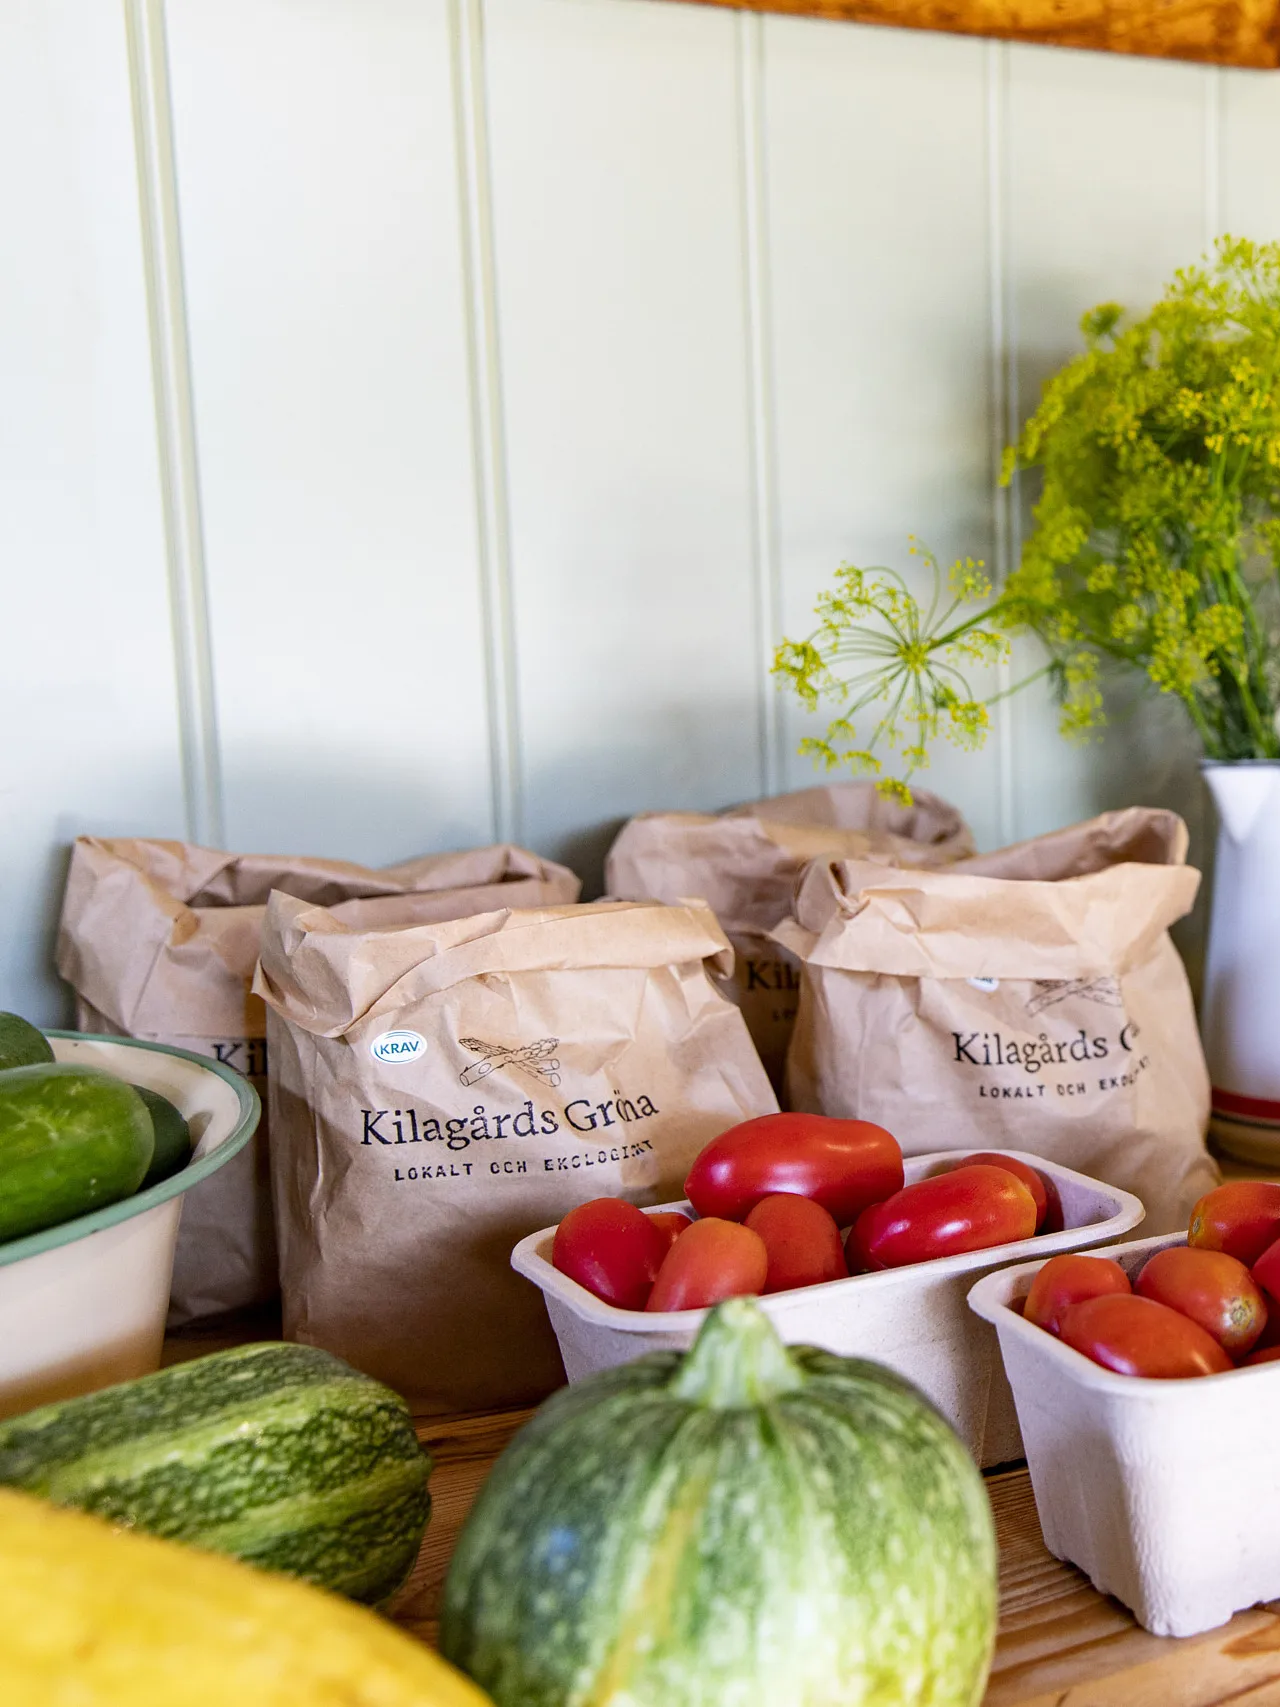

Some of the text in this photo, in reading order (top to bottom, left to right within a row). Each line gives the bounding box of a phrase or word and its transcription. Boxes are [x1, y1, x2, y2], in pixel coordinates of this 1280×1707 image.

[380, 1040, 419, 1055] KRAV
[952, 1030, 1109, 1074] Kilagårds
[979, 1082, 1086, 1098] LOKALT OCH
[360, 1100, 560, 1150] Kilagårds
[395, 1163, 473, 1181] LOKALT
[491, 1160, 527, 1175] OCH
